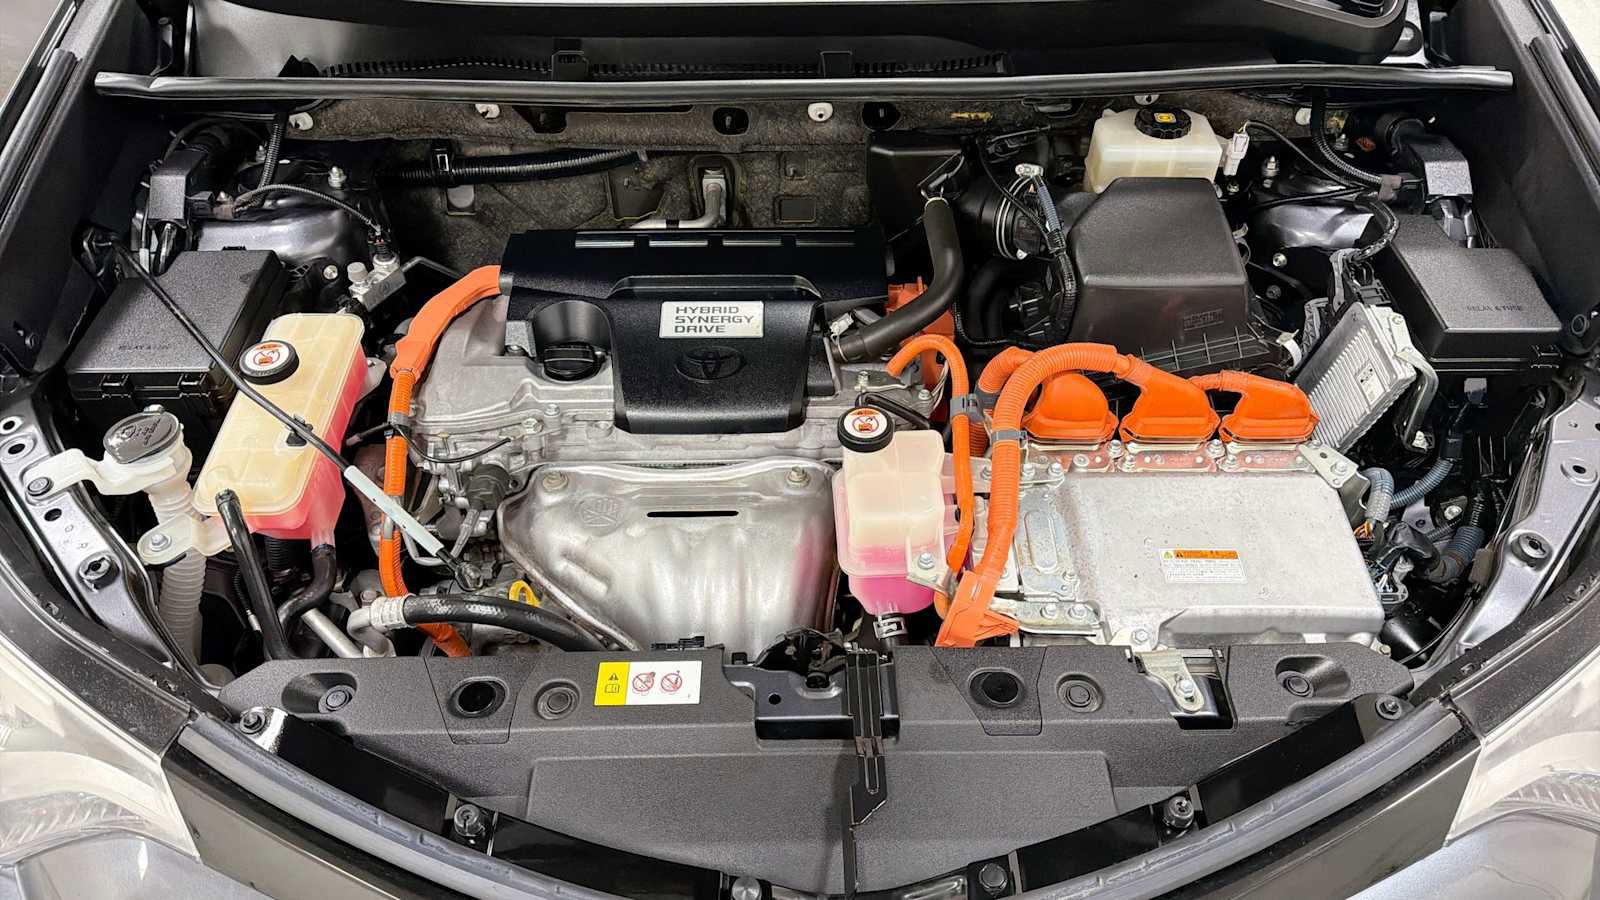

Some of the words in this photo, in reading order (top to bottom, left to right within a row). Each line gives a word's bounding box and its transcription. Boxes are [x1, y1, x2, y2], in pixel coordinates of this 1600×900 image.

[675, 306, 740, 314] HYBRID
[674, 315, 754, 324] SYNERGY
[674, 325, 727, 334] DRIVE
